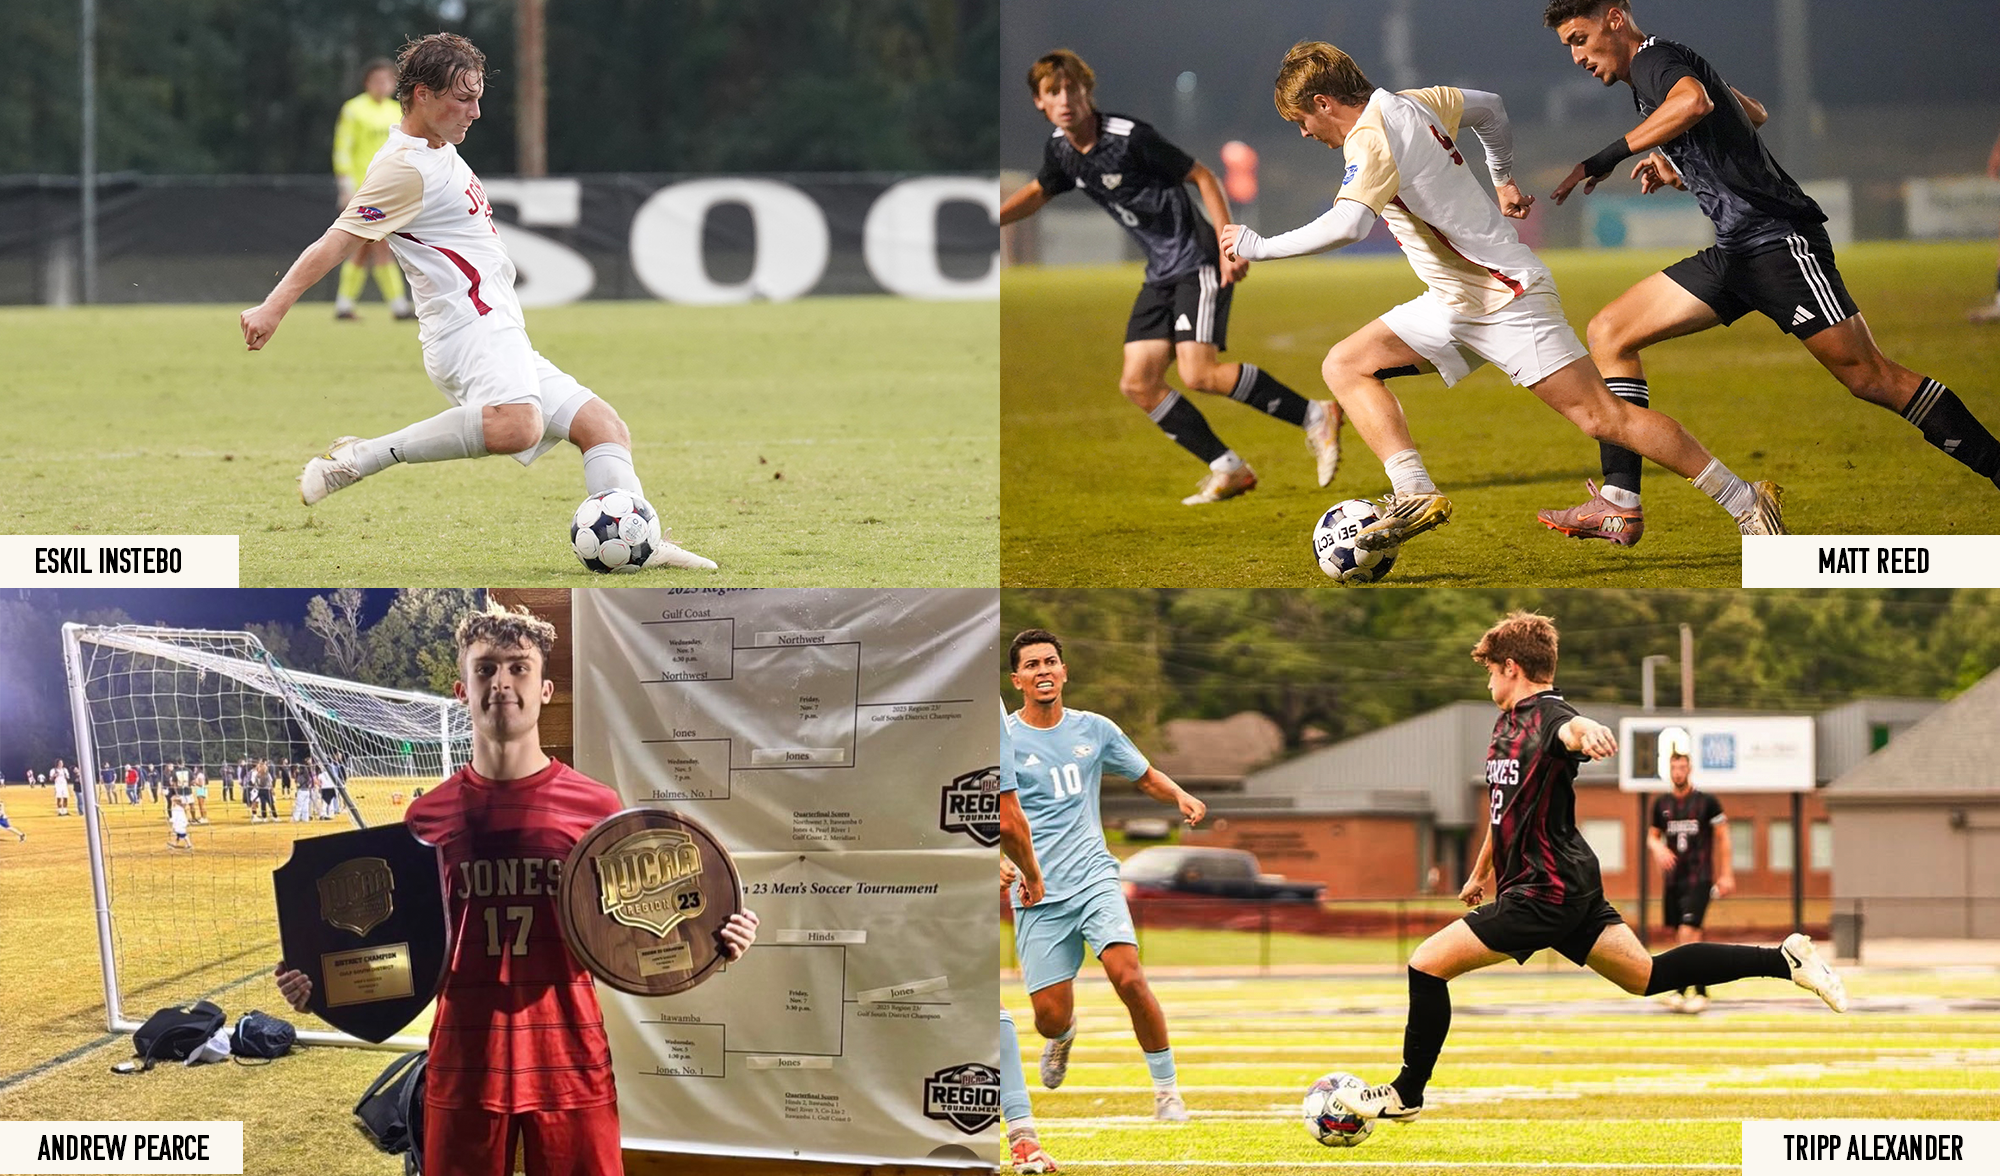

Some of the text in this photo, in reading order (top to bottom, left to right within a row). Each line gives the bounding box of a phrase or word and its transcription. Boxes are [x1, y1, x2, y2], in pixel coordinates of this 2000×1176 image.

[662, 608, 711, 620] Gulf Coast
[777, 635, 825, 645] Northwest
[662, 671, 708, 681] Northwest
[871, 714, 886, 722] Gulf
[672, 728, 696, 738] Jones
[785, 752, 810, 762] Jones
[1050, 763, 1083, 800] 10
[652, 789, 713, 800] Holmes, No. 1
[958, 813, 1000, 822] TOURNA
[457, 858, 562, 899] JONES
[599, 843, 702, 907] NJCAA
[752, 883, 768, 895] 23
[771, 882, 807, 895] Men's
[810, 882, 852, 895] Soccer
[856, 882, 939, 895] Tournament
[626, 891, 701, 916] REGION 23
[483, 906, 534, 956] 17
[807, 932, 835, 942] Hinds
[890, 988, 915, 998] Jones
[660, 1013, 701, 1022] Itawamba
[778, 1058, 801, 1067] Jones
[656, 1065, 704, 1075] Jones, No. 1
[931, 1085, 1000, 1106] REGIO
[940, 1104, 1000, 1113] TOURNAMEN
